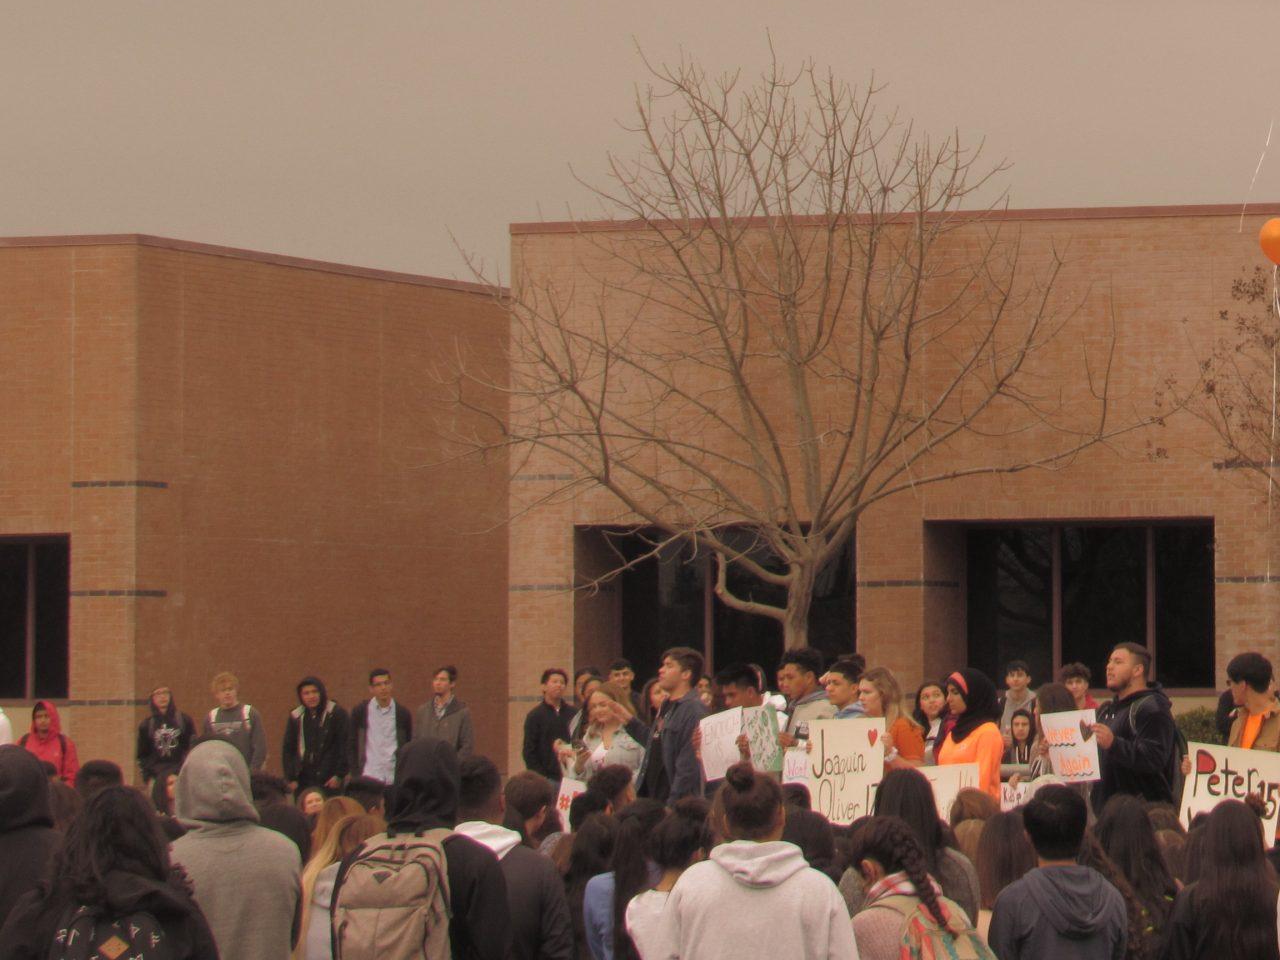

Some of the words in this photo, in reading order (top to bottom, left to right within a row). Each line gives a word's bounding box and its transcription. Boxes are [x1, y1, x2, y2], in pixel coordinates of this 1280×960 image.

[818, 779, 860, 821] Oliver
[1193, 748, 1260, 799] Peter
[1257, 780, 1279, 821] 15
